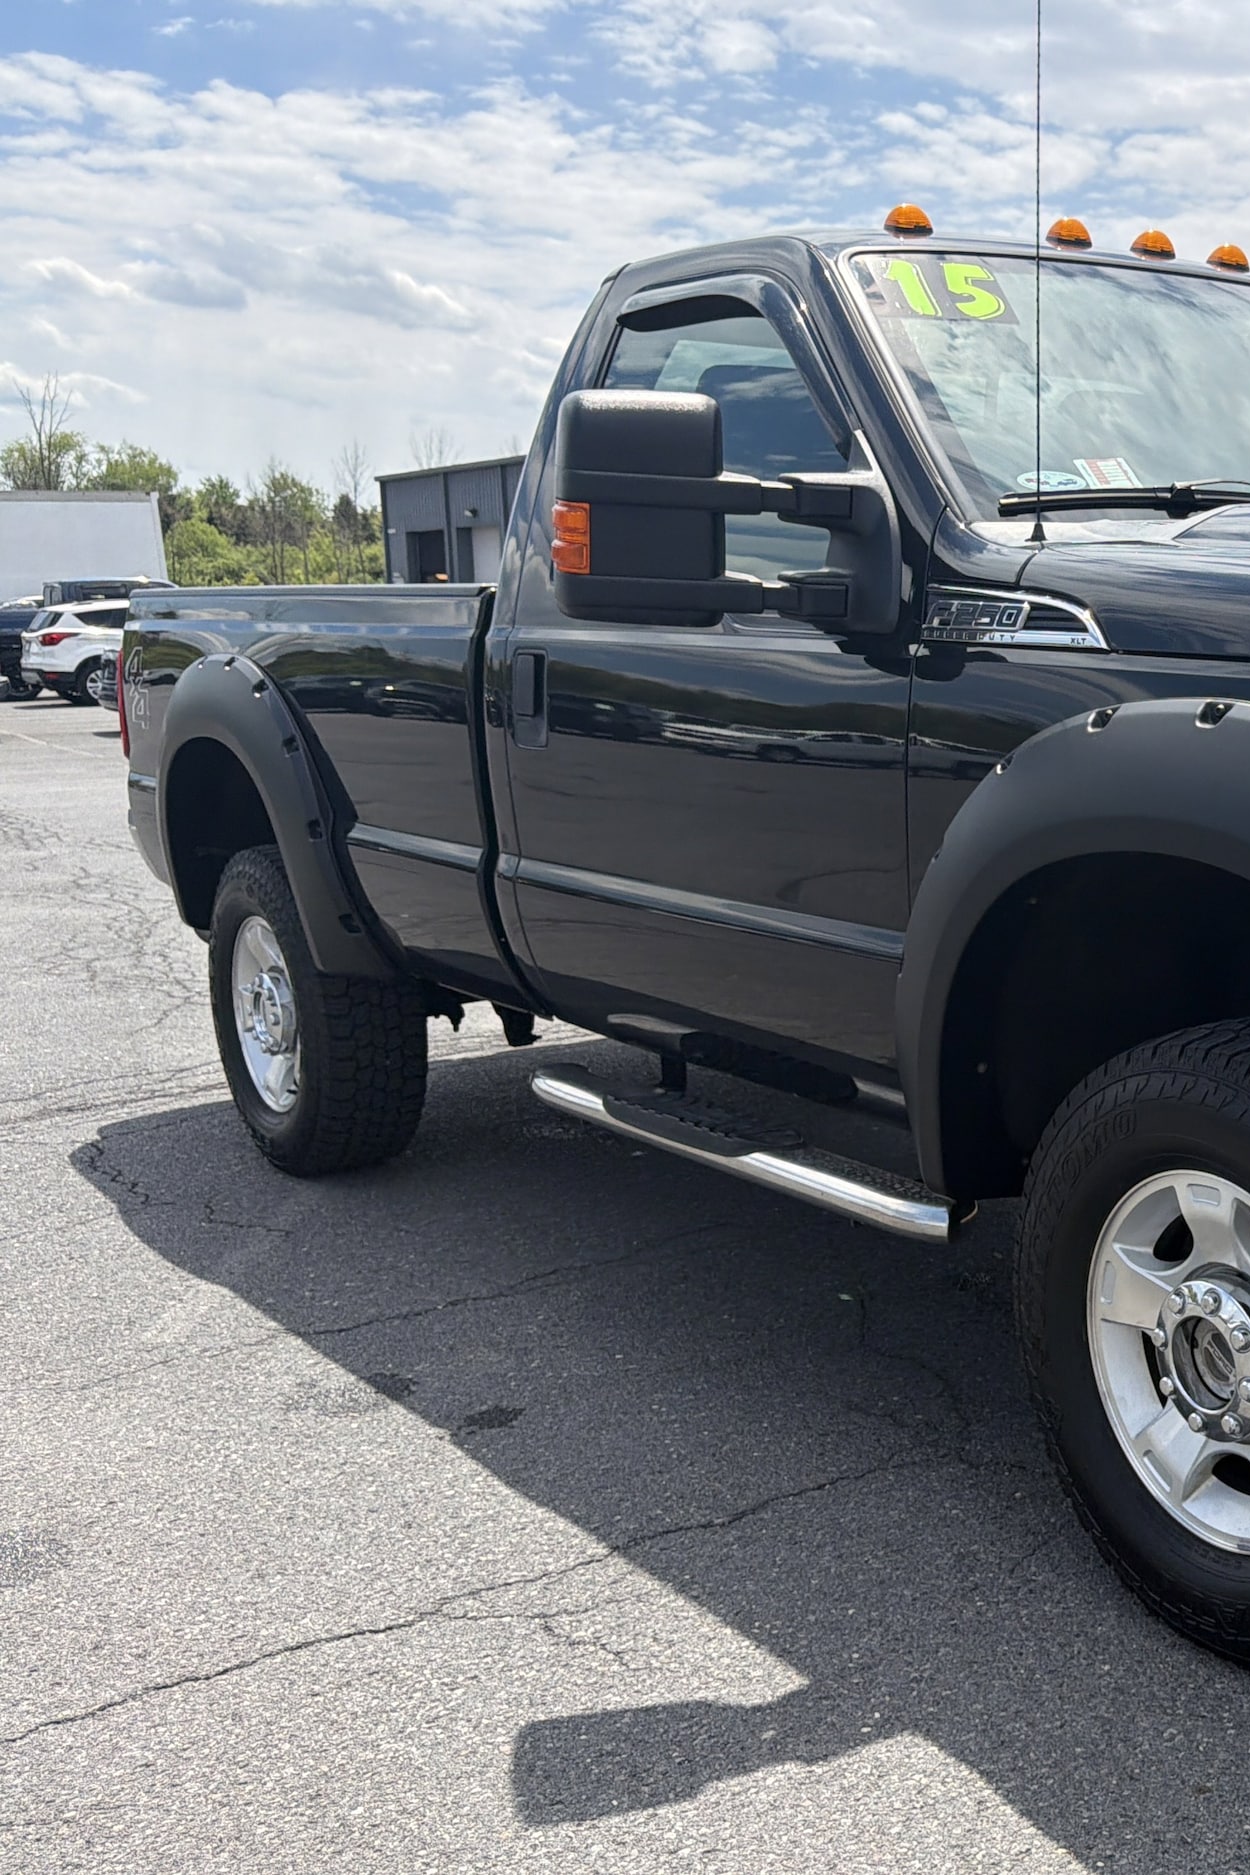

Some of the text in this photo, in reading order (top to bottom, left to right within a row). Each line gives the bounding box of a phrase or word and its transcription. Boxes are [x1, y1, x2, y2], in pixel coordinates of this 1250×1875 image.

[885, 259, 1006, 320] 15
[976, 631, 1017, 642] DUTY
[1070, 637, 1088, 646] XLT
